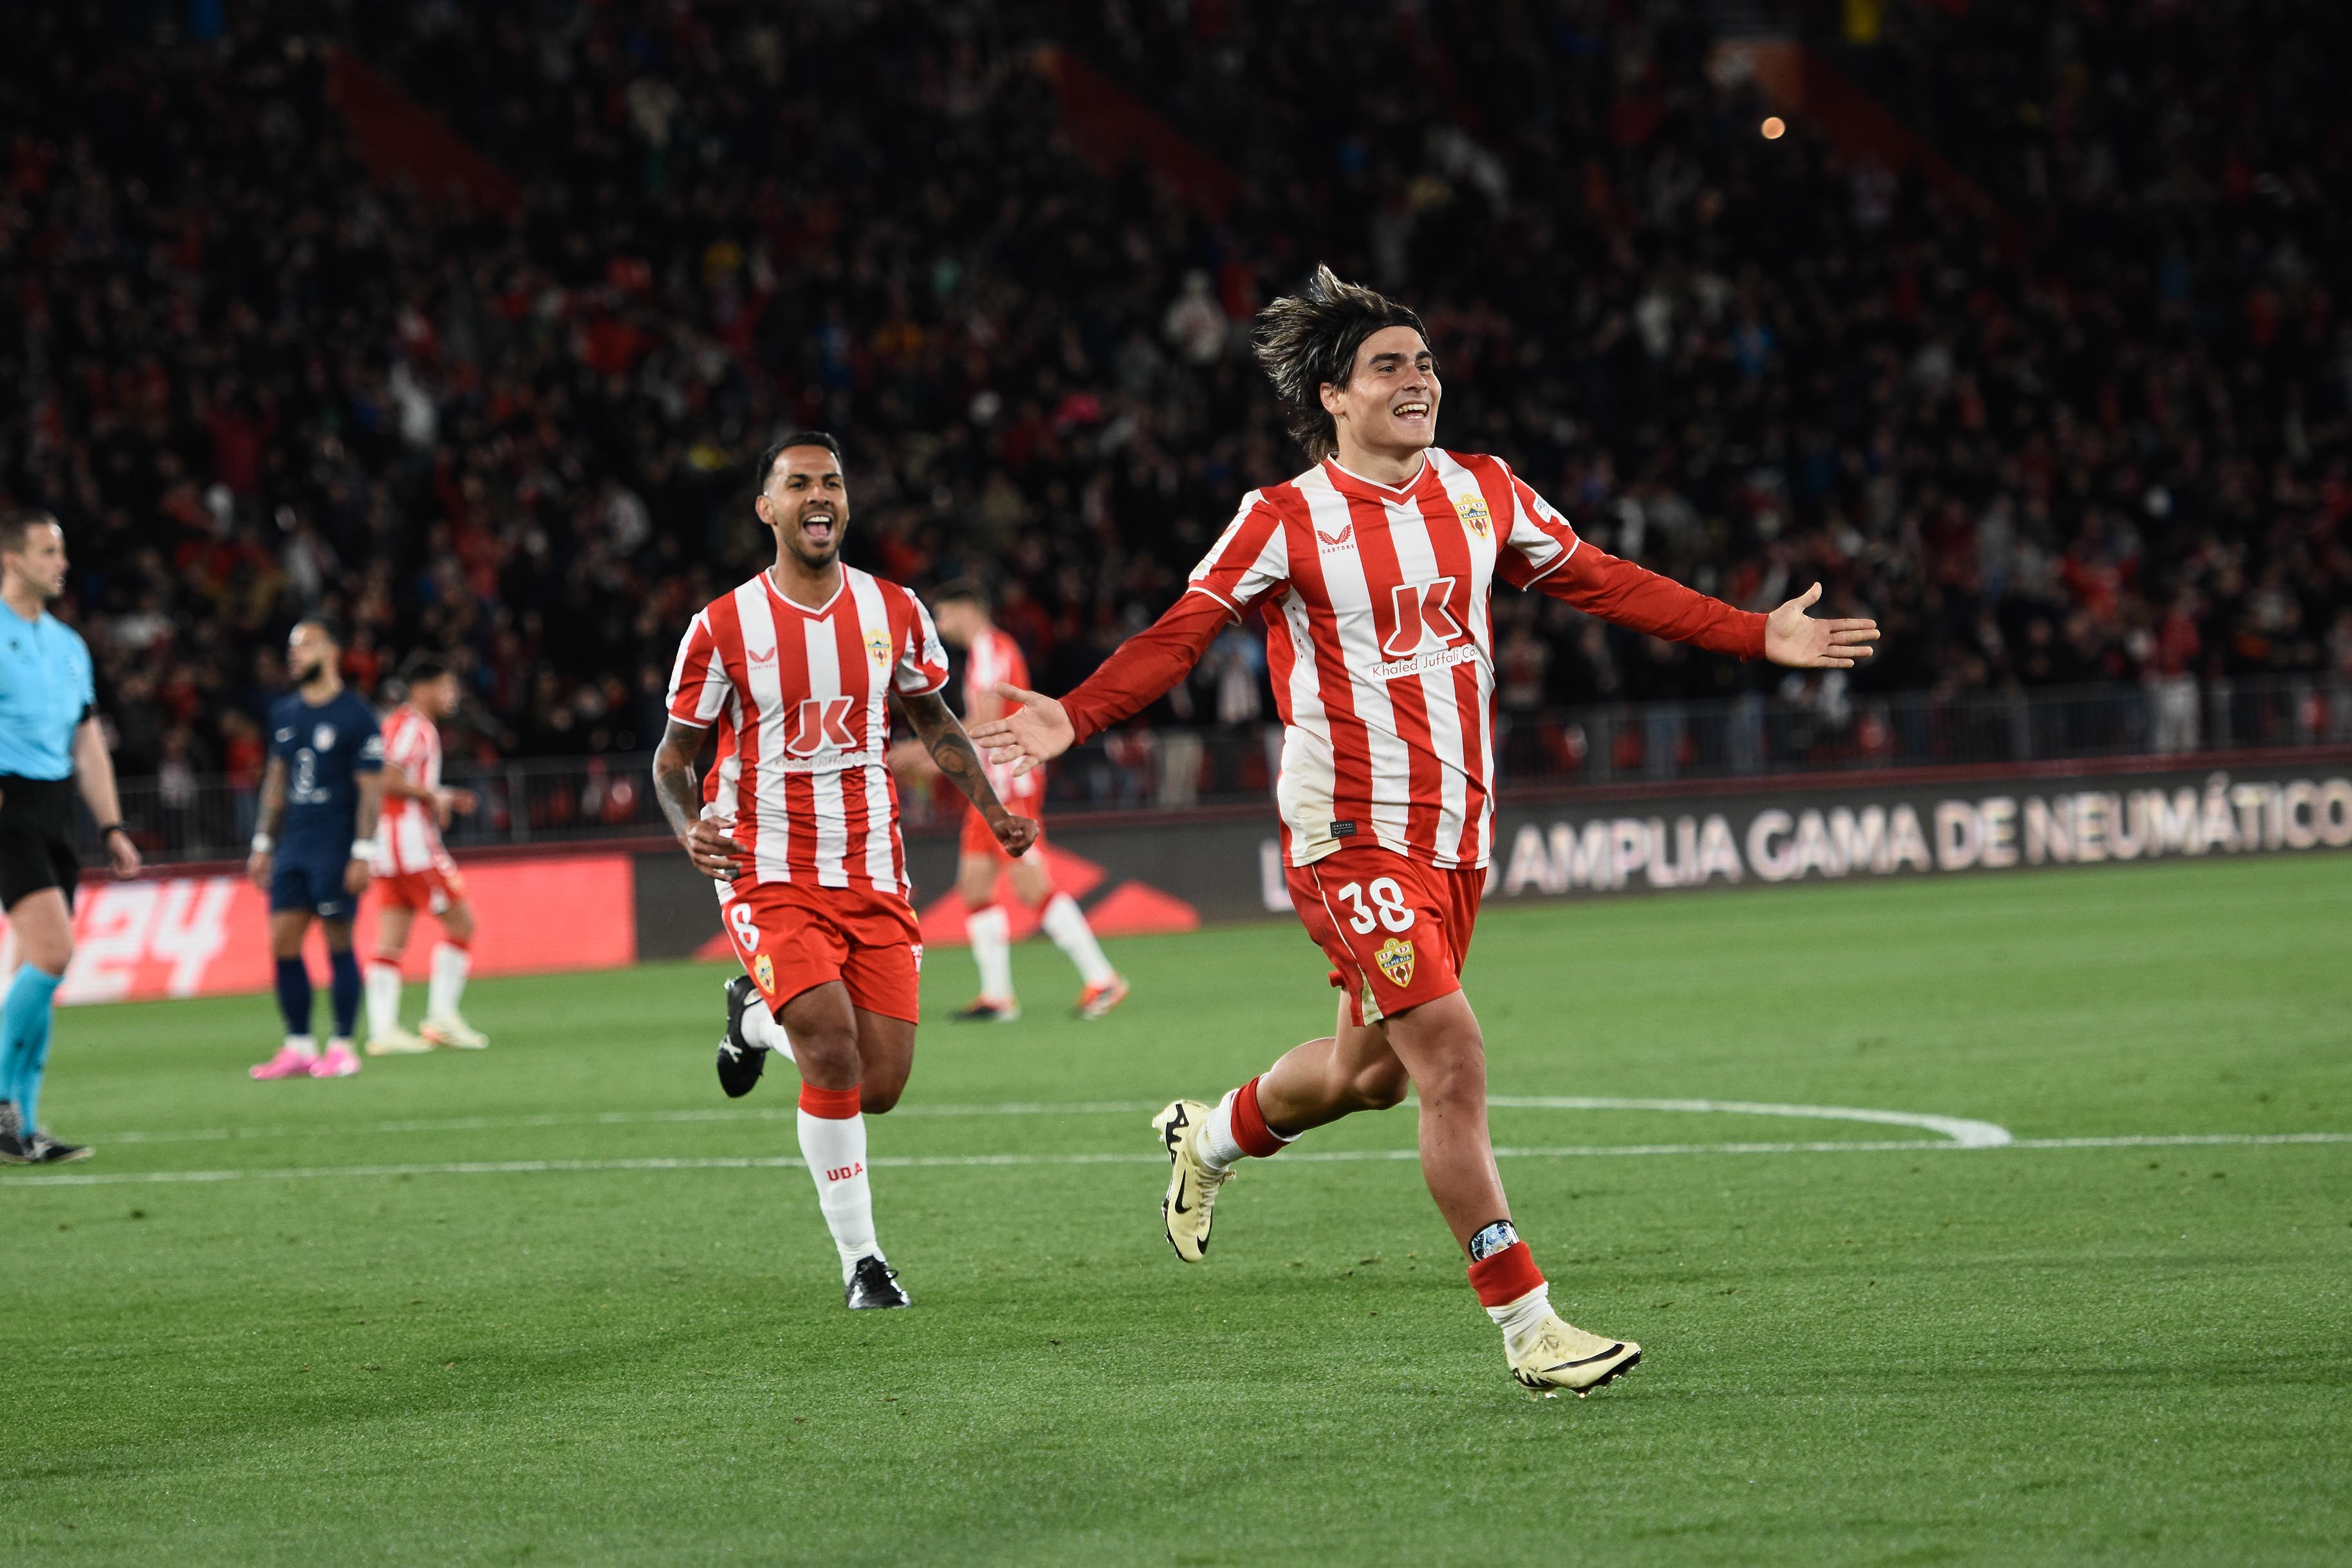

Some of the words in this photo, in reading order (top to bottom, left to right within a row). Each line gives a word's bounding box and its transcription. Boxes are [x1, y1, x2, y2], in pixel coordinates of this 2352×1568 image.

[1322, 544, 1355, 555] CASTORE
[1387, 580, 1459, 654] JK
[1373, 658, 1418, 678] Khaled
[1423, 649, 1459, 669] Juffali
[1462, 646, 1478, 658] Co.
[790, 699, 853, 753] JK
[1505, 813, 1744, 897] AMPLIA
[1745, 803, 1931, 882] GAMA
[1933, 796, 2019, 871] DE
[730, 902, 760, 953] 8
[1338, 876, 1415, 935] 38
[61, 880, 237, 1004] 24
[1384, 955, 1411, 968] ALMERIA
[826, 1162, 864, 1182] UDA
